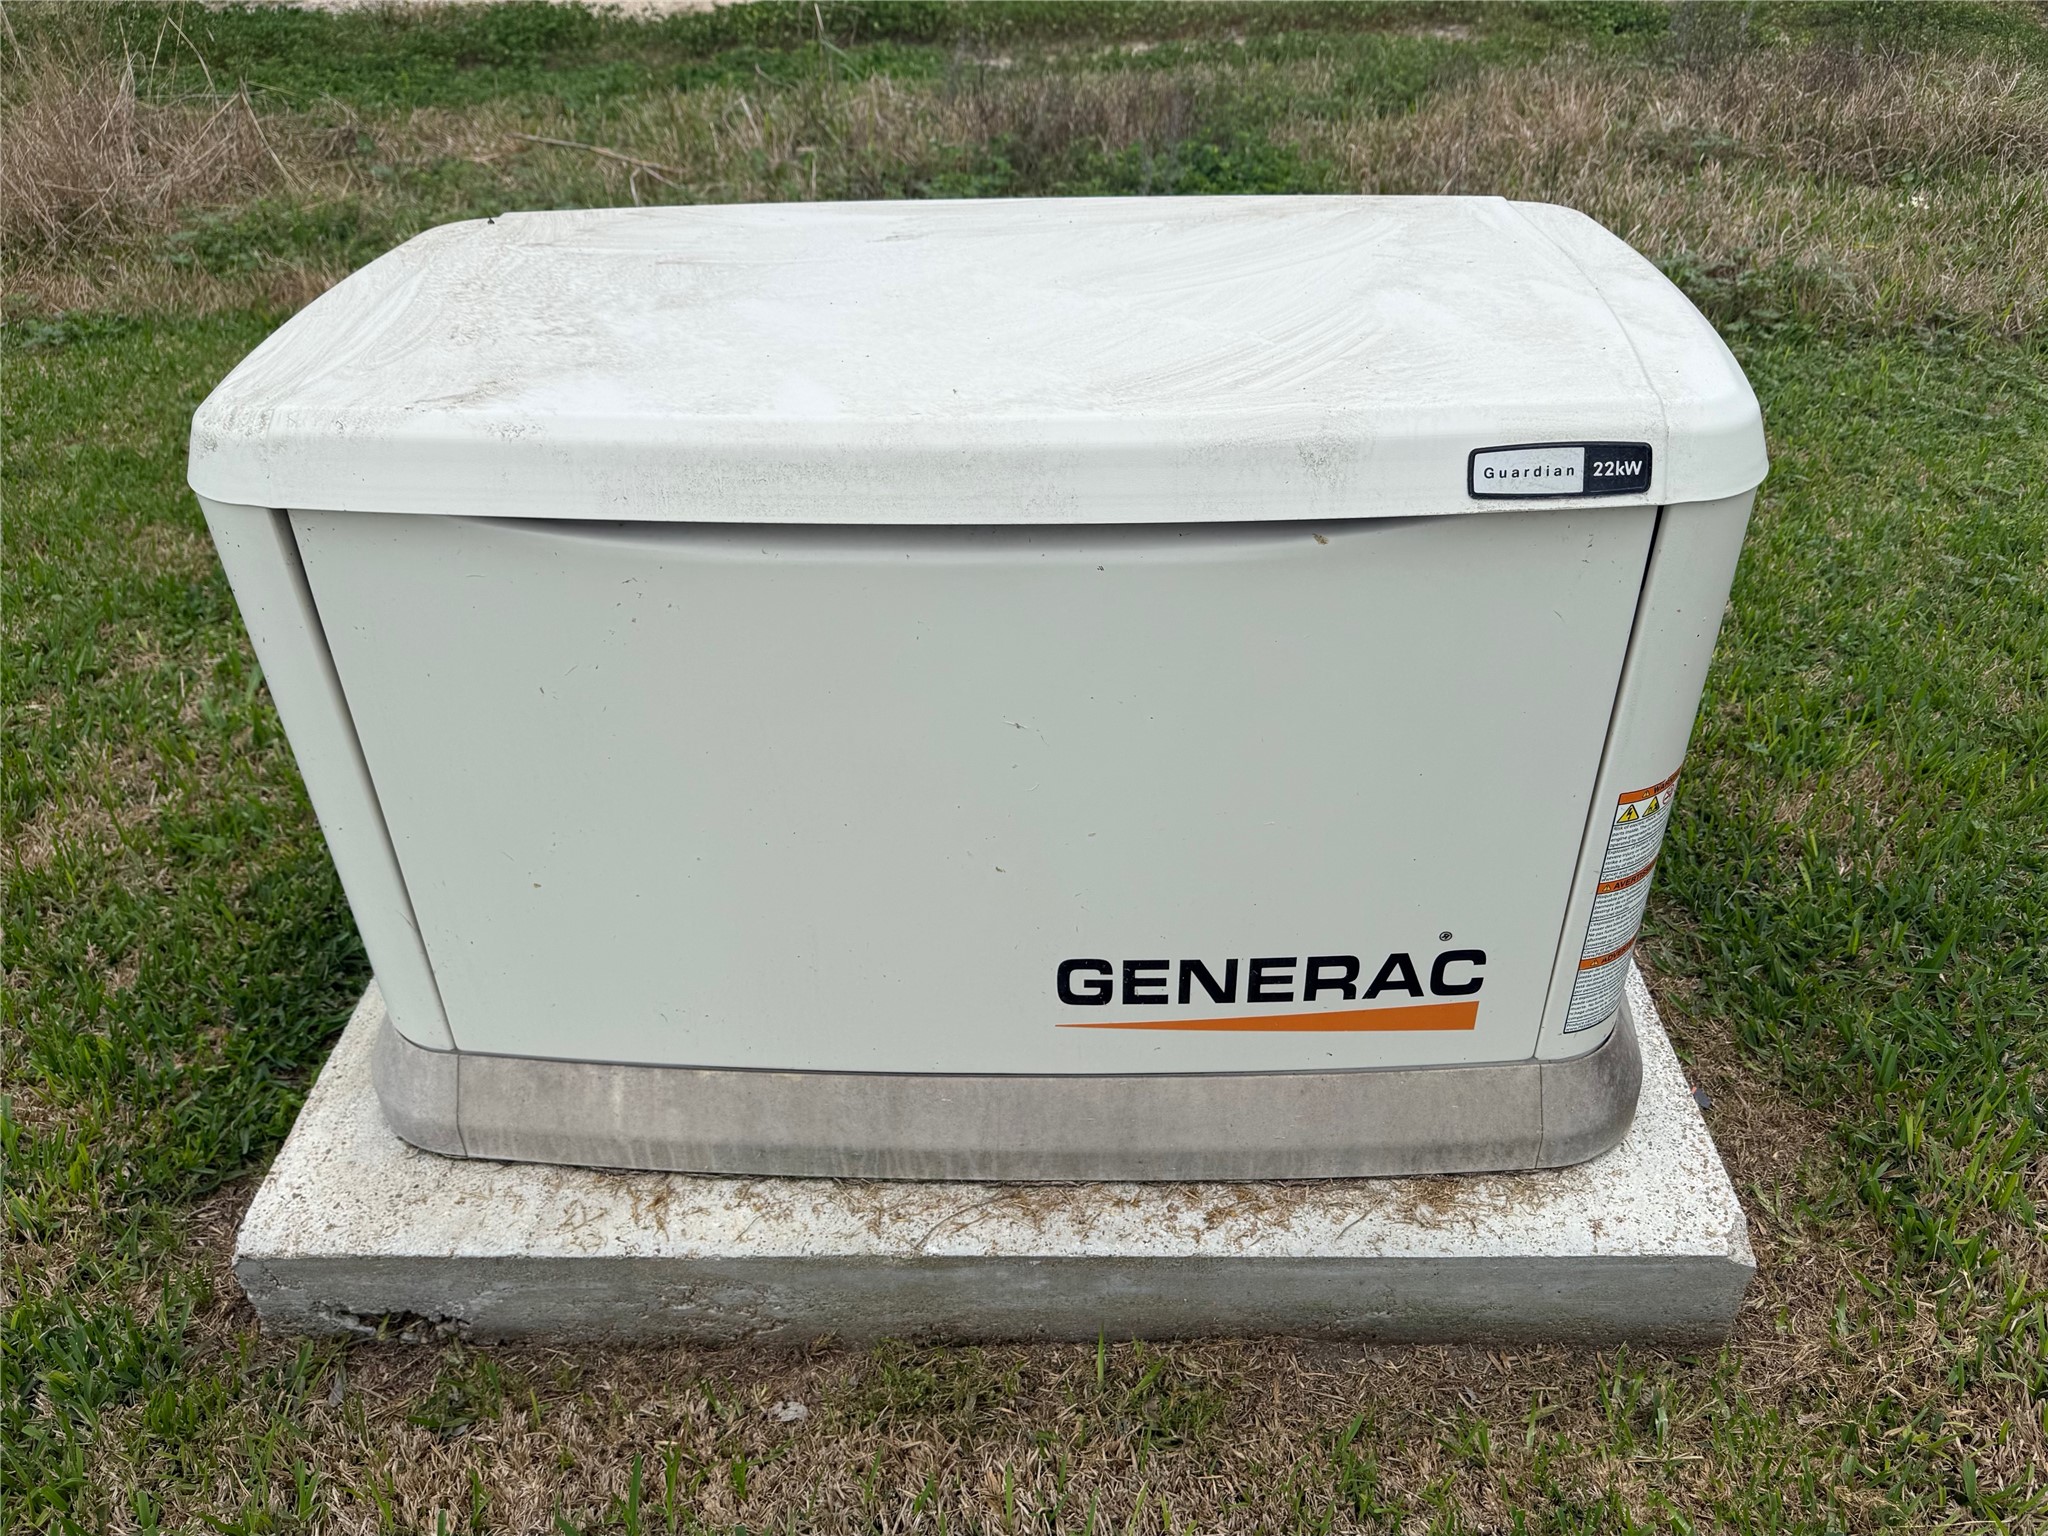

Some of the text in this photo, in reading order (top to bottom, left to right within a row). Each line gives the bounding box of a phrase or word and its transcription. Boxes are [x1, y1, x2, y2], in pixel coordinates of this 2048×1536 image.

[1483, 460, 1643, 479] Guardian 22kW
[1056, 948, 1487, 1006] GENERAC
